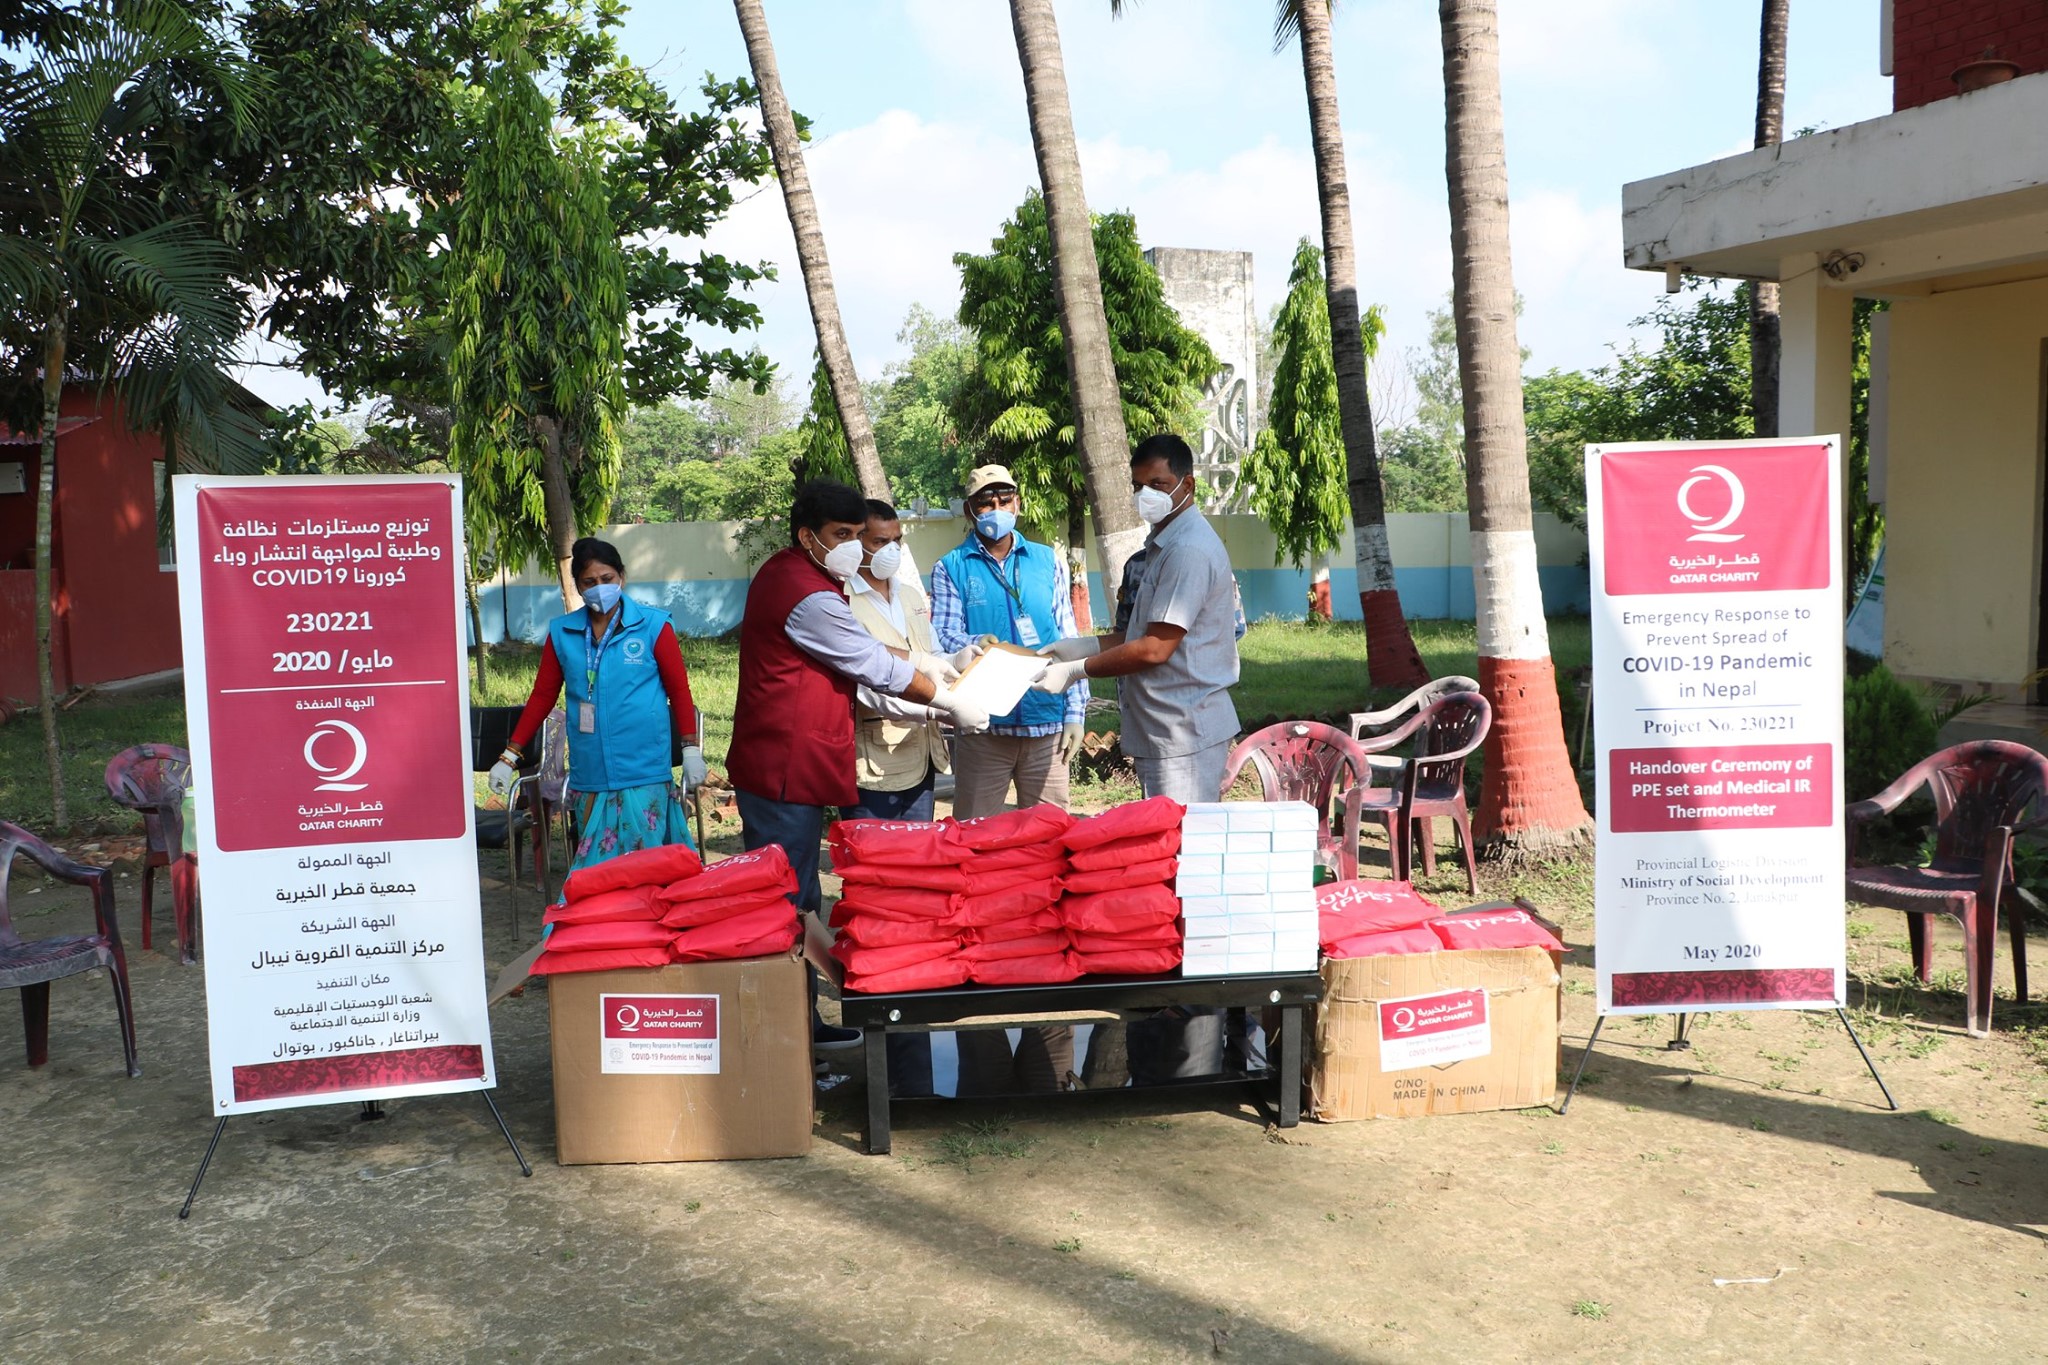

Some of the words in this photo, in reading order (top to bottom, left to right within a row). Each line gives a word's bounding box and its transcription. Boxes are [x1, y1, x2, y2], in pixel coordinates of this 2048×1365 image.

[223, 521, 276, 538] نظافة
[288, 518, 380, 540] مستلزمات
[385, 517, 429, 538] توزيع
[213, 547, 247, 567] وباء
[252, 545, 306, 564] انتشار
[312, 544, 382, 565] لمواجهة
[388, 542, 440, 560] وطبية
[1669, 555, 1715, 569] الخيرية
[253, 568, 347, 586] COVID19
[354, 567, 405, 586] كورونا
[1670, 573, 1707, 583] QATAR
[1710, 572, 1759, 583] CHARITY
[287, 612, 372, 633] 230221
[1623, 610, 1709, 626] Emergency
[1715, 610, 1789, 623] Response
[1795, 609, 1810, 619] to
[1647, 633, 1707, 646] Prevent
[1713, 632, 1767, 646] Spread
[1772, 629, 1788, 641] of
[273, 651, 330, 672] 2020
[1623, 657, 1714, 673] COVID-19
[1721, 653, 1812, 670] Pandemic
[1679, 683, 1695, 697] in
[1702, 681, 1756, 699] Nepal
[296, 697, 341, 711] المنفذة
[345, 696, 374, 711] الجهة
[1644, 719, 1700, 736] Project
[1707, 720, 1734, 732] No.
[1741, 717, 1794, 731] 230221
[1630, 760, 1707, 775] Handover
[1711, 759, 1791, 774] Ceremony
[1796, 756, 1812, 770] of
[1632, 784, 1661, 796] PPE
[1666, 784, 1689, 796] set
[1694, 782, 1722, 795] and
[1727, 780, 1790, 794] Medical
[1794, 779, 1811, 792] IR
[298, 802, 341, 816] الخيرية
[1667, 804, 1776, 818] Thermometer
[299, 819, 334, 831] QATAR
[337, 817, 383, 829] CHARITY
[298, 853, 352, 871] الممولة
[356, 852, 391, 869] الجهة
[1637, 858, 1698, 870] Provincial
[370, 880, 416, 896] جمعية
[1621, 876, 1675, 890] Ministry
[1680, 876, 1694, 886] of
[1696, 875, 1734, 886] Social
[1740, 874, 1823, 888] Development
[276, 883, 326, 903] الخيرية
[332, 882, 365, 900] قطر
[1646, 894, 1699, 906] Province
[1702, 892, 1725, 904] No.
[301, 917, 357, 935] الشريكة
[362, 915, 395, 930] الجهة
[295, 945, 349, 963] القروية
[354, 941, 406, 960] التنمية
[412, 941, 444, 955] مركز
[1684, 946, 1719, 962] May
[1724, 944, 1761, 958] 2020
[251, 950, 289, 969] نيبال
[316, 976, 357, 991] التنفيذ
[361, 973, 390, 986] مكان
[331, 994, 398, 1012] اللوجستيات
[401, 991, 432, 1006] شعبة
[274, 999, 326, 1018] الإقليمية
[393, 1009, 420, 1024] وزارة
[643, 1009, 673, 1018] الخيرية
[290, 1015, 347, 1032] الاجتماعية
[350, 1010, 389, 1027] التنمية
[1418, 1018, 1442, 1026] QATAR
[1443, 1011, 1473, 1022] CHARITY
[273, 1041, 315, 1058] بوتوال
[328, 1035, 375, 1052] جاناكبور
[653, 1042, 671, 1050] Response
[696, 1054, 712, 1062] Nepal
[1394, 1089, 1426, 1099] MADE
[1433, 1088, 1444, 1096] IN
[1450, 1085, 1485, 1096] CHINA
